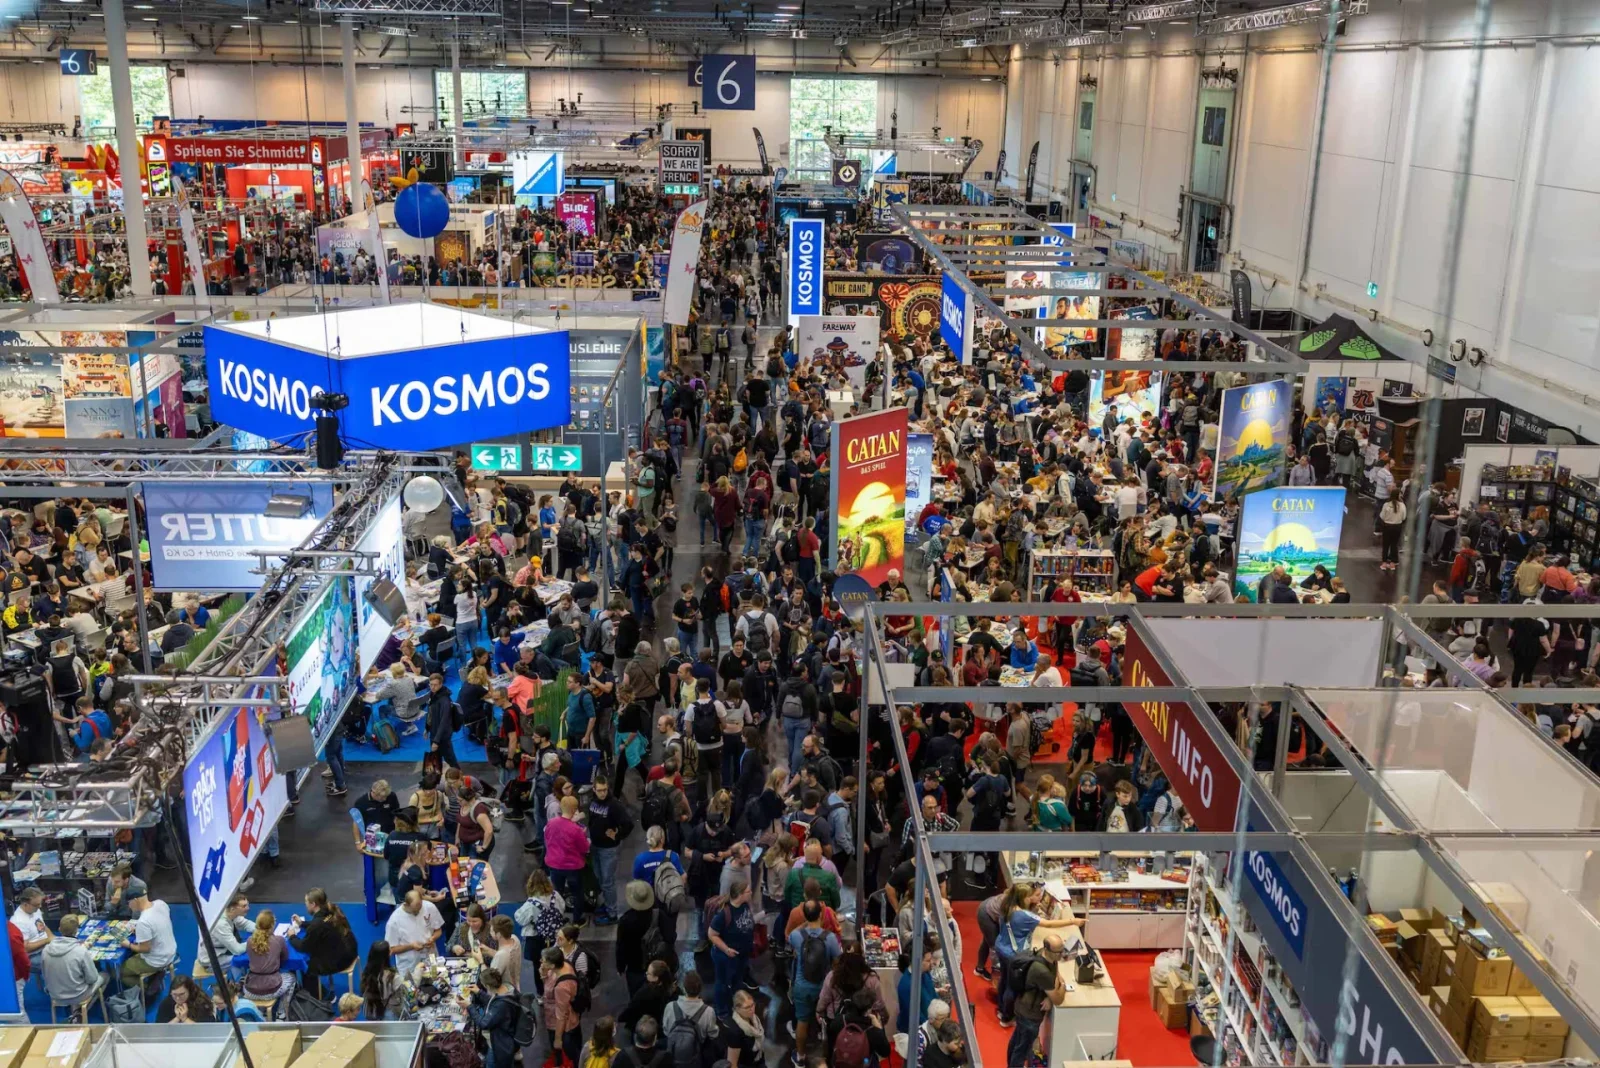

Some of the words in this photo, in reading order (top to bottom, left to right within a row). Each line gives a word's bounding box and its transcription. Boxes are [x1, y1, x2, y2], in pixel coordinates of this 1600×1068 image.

[68, 52, 80, 73] 6
[717, 60, 740, 104] 6
[174, 144, 221, 159] Spielen
[225, 145, 245, 157] Sie
[248, 145, 306, 159] Schmidt!
[663, 145, 698, 157] SORRY
[664, 160, 677, 169] WE
[680, 159, 698, 169] ARE
[663, 171, 698, 183] FRENCH
[563, 203, 588, 213] SLIDE
[329, 240, 361, 248] PIGEONS
[798, 229, 814, 306] KOSMOS
[834, 284, 846, 292] THE
[848, 284, 867, 293] GANG
[371, 363, 551, 426] KOSMOS
[847, 429, 900, 463] CATAN
[861, 465, 871, 474] DAS
[872, 462, 886, 471] SPIEL
[1272, 497, 1315, 511] CATAN
[842, 592, 869, 600] CATAN
[1171, 719, 1213, 809] INFO
[192, 765, 217, 817] CRACK
[199, 793, 215, 835] LIST
[1248, 850, 1300, 936] KOSMOS
